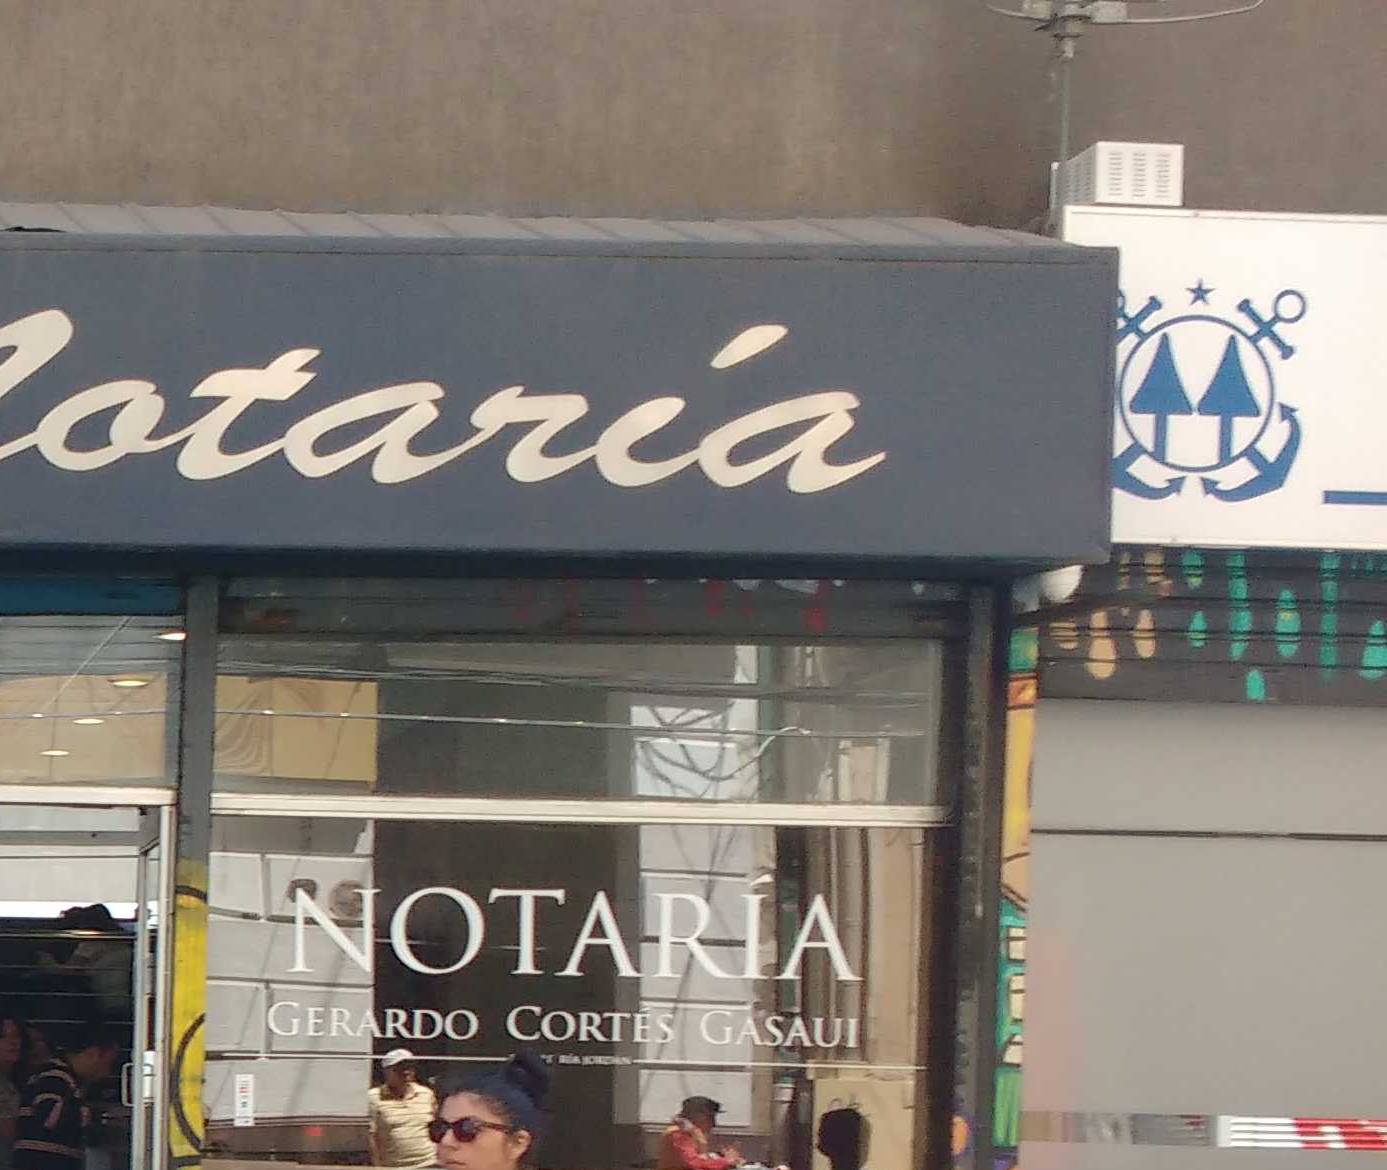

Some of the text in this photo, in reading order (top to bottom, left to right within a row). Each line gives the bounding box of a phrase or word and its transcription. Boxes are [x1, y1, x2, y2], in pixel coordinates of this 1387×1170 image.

[286, 873, 864, 982] NOTARÍA
[267, 1001, 860, 1049] GERARDO CORTÉS GASAUI
